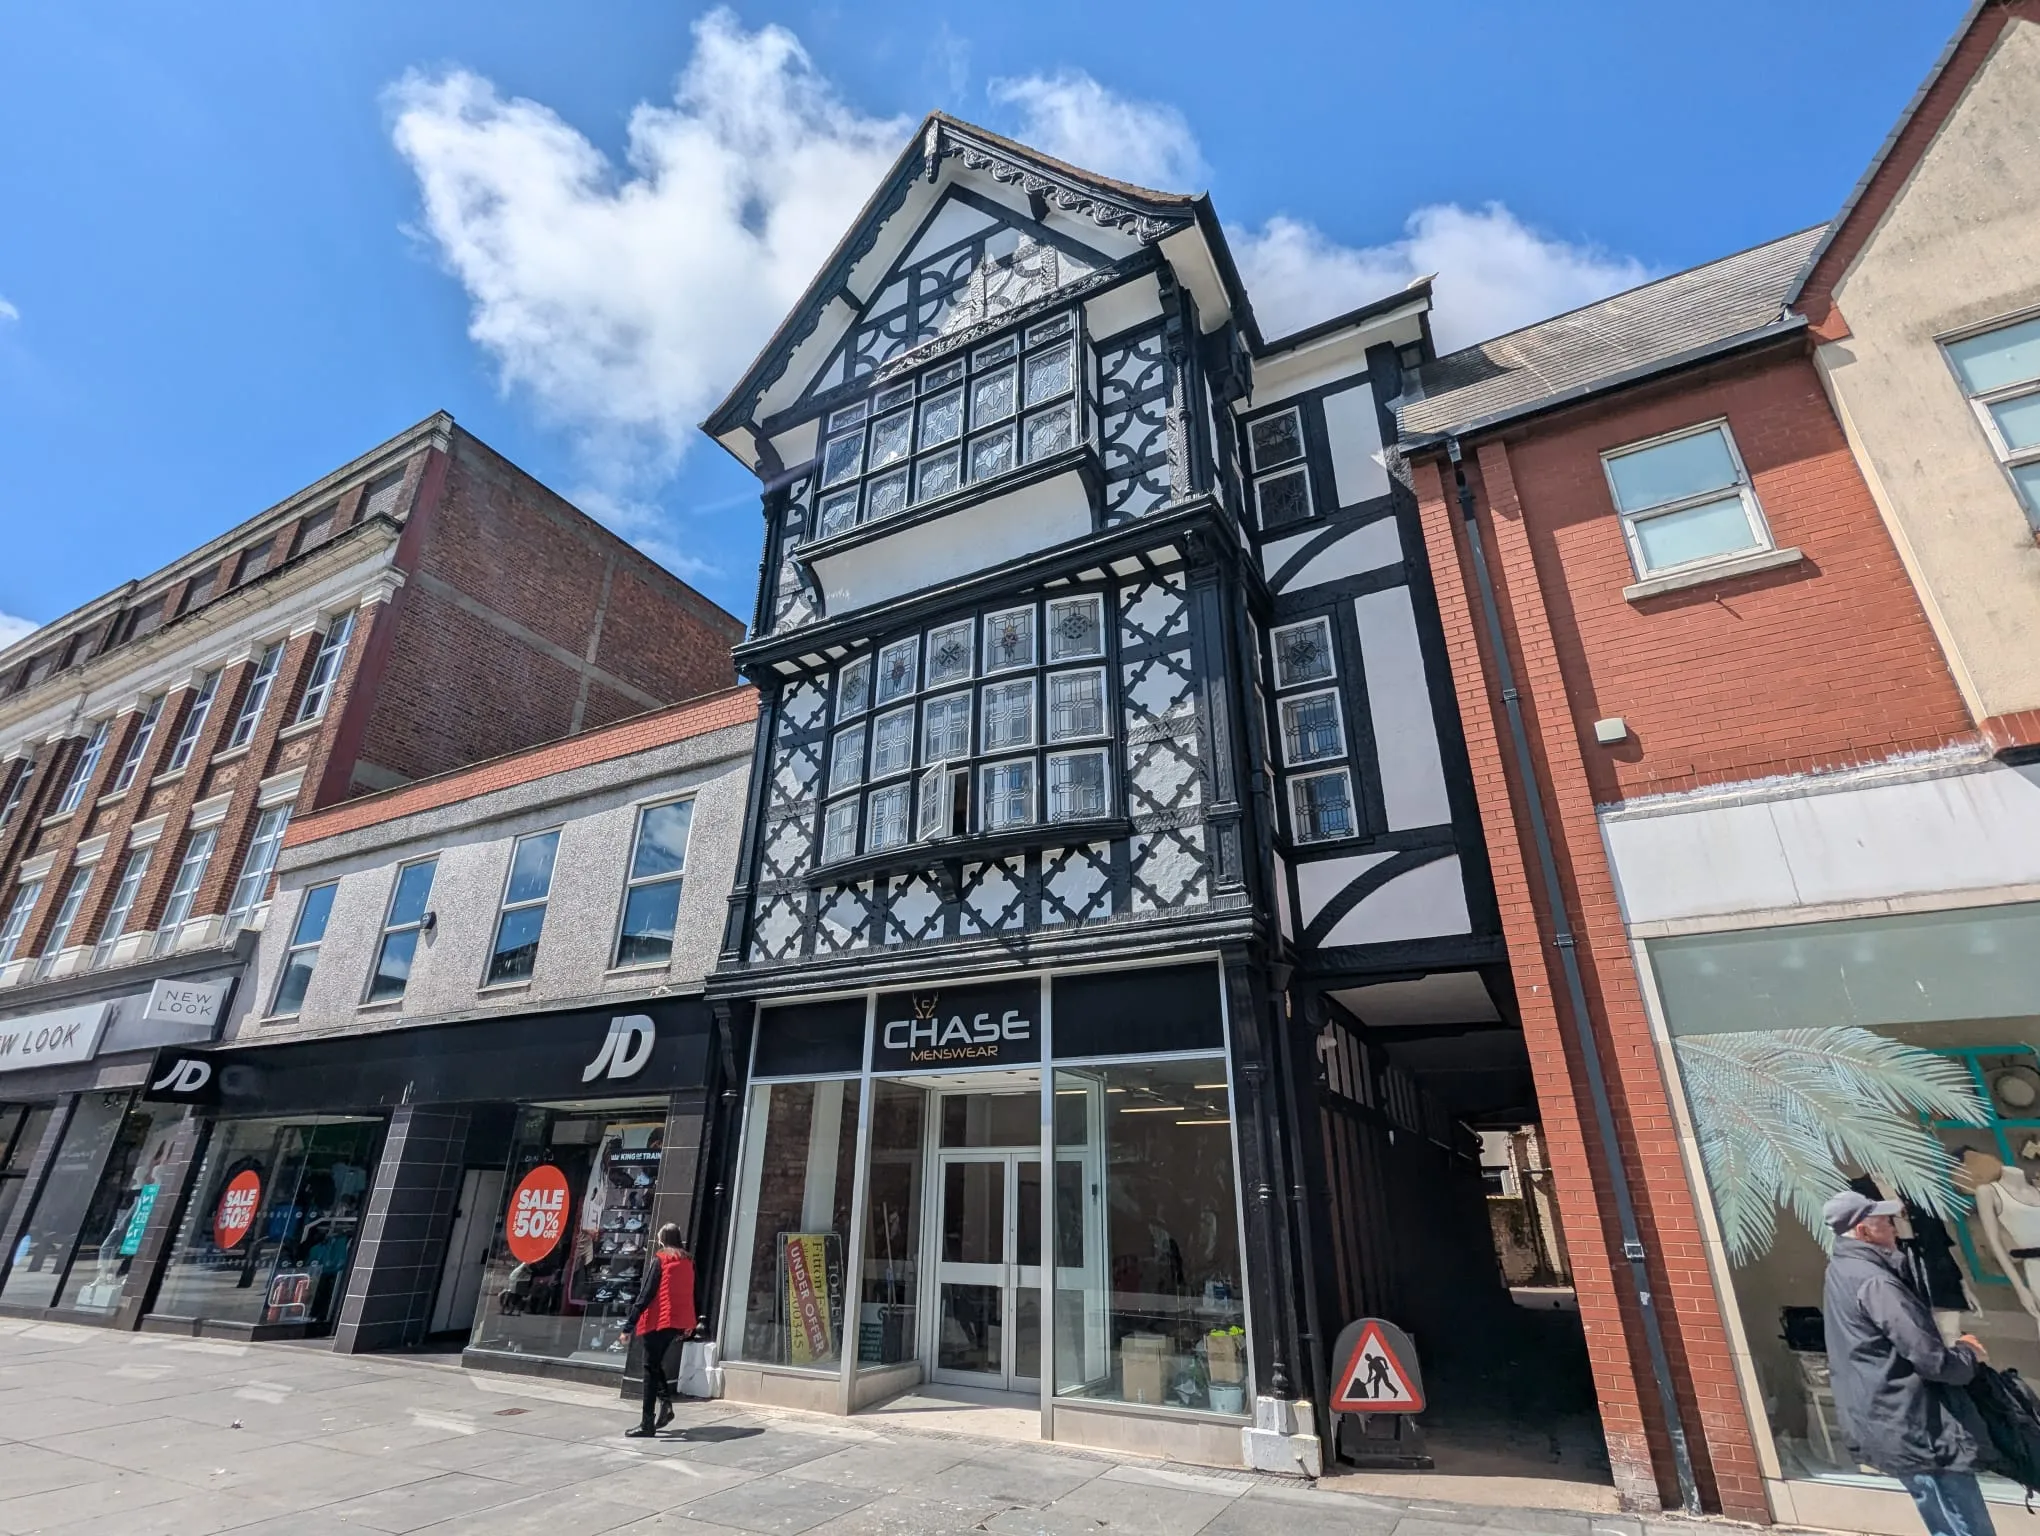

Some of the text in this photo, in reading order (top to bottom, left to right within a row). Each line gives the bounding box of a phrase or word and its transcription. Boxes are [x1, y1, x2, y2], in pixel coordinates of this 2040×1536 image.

[165, 989, 212, 1004] NEW
[921, 1000, 930, 1009] C
[157, 1003, 214, 1016] LOOK
[22, 1022, 81, 1055] LOOK
[884, 1010, 1030, 1049] CHASE
[582, 1014, 656, 1083] JD
[910, 1045, 999, 1062] MENSWEAR
[152, 1059, 212, 1092] JD
[620, 1152, 636, 1161] KING
[224, 1188, 257, 1208] SALE
[517, 1189, 565, 1210] SALE
[219, 1207, 250, 1230] 50%
[514, 1210, 560, 1239] 50%
[543, 1229, 558, 1239] OFF
[812, 1242, 823, 1289] Fitton
[790, 1246, 825, 1353] UNDER OFFER
